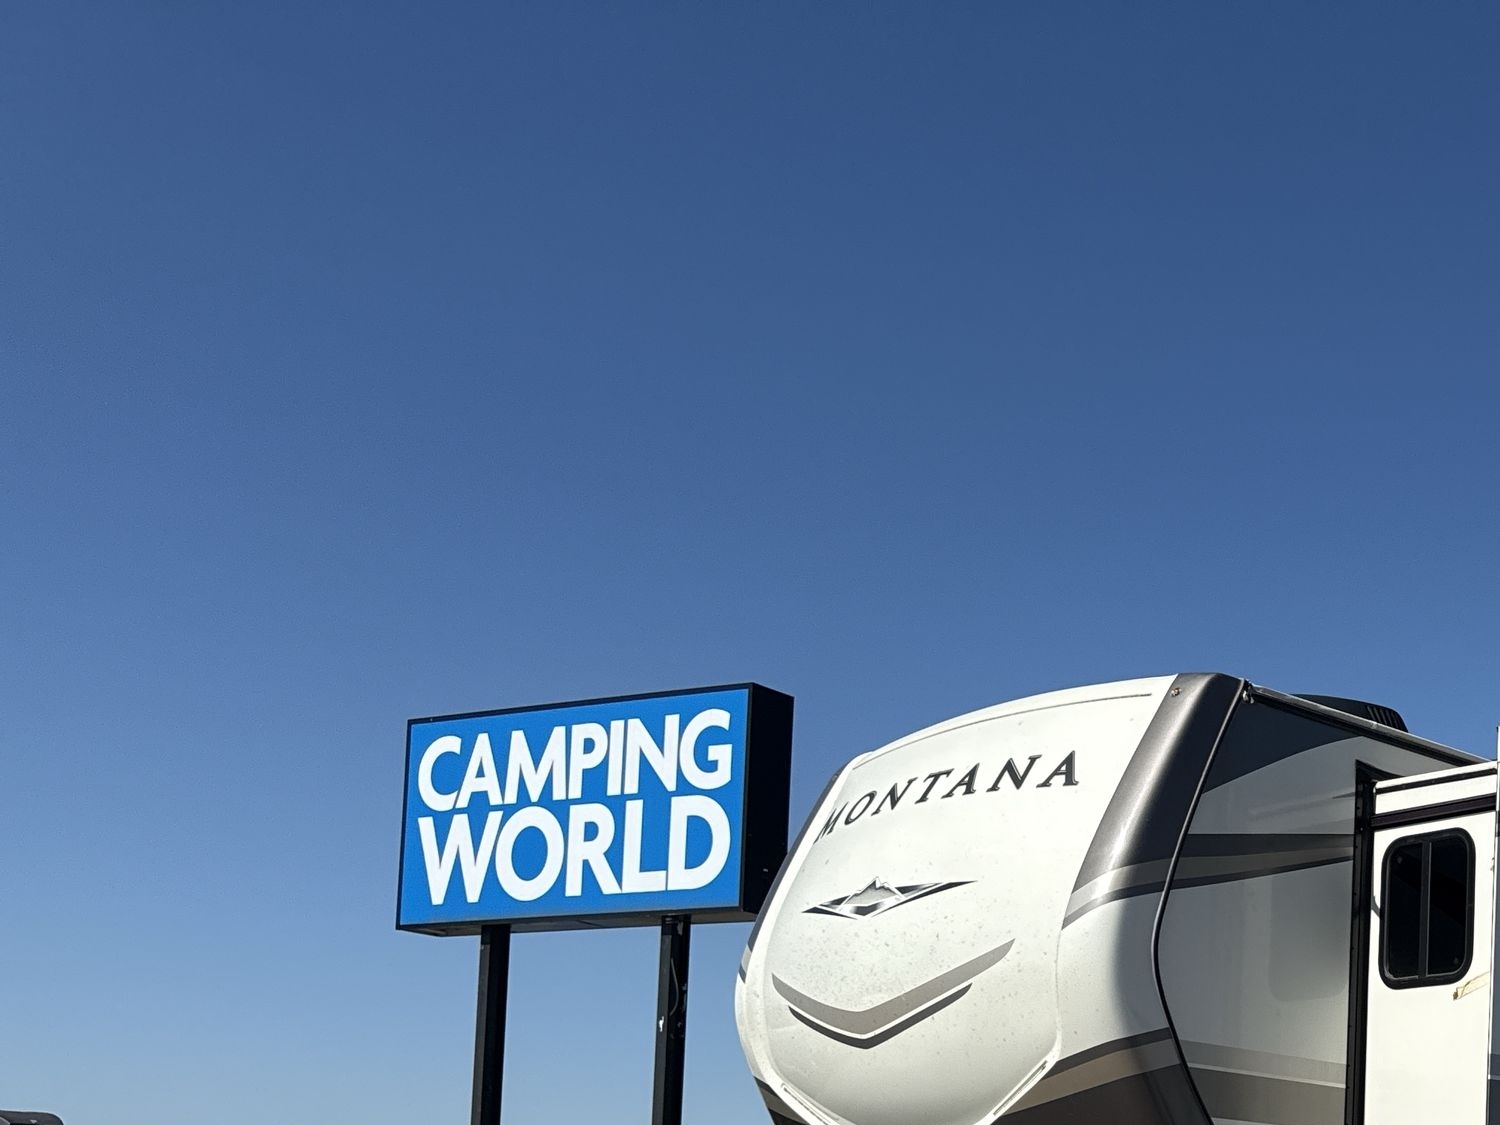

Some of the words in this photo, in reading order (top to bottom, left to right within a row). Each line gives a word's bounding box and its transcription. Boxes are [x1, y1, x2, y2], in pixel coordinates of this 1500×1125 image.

[418, 708, 733, 812] CAMPING
[813, 750, 1079, 845] MONTANA
[418, 794, 731, 906] WORLD
